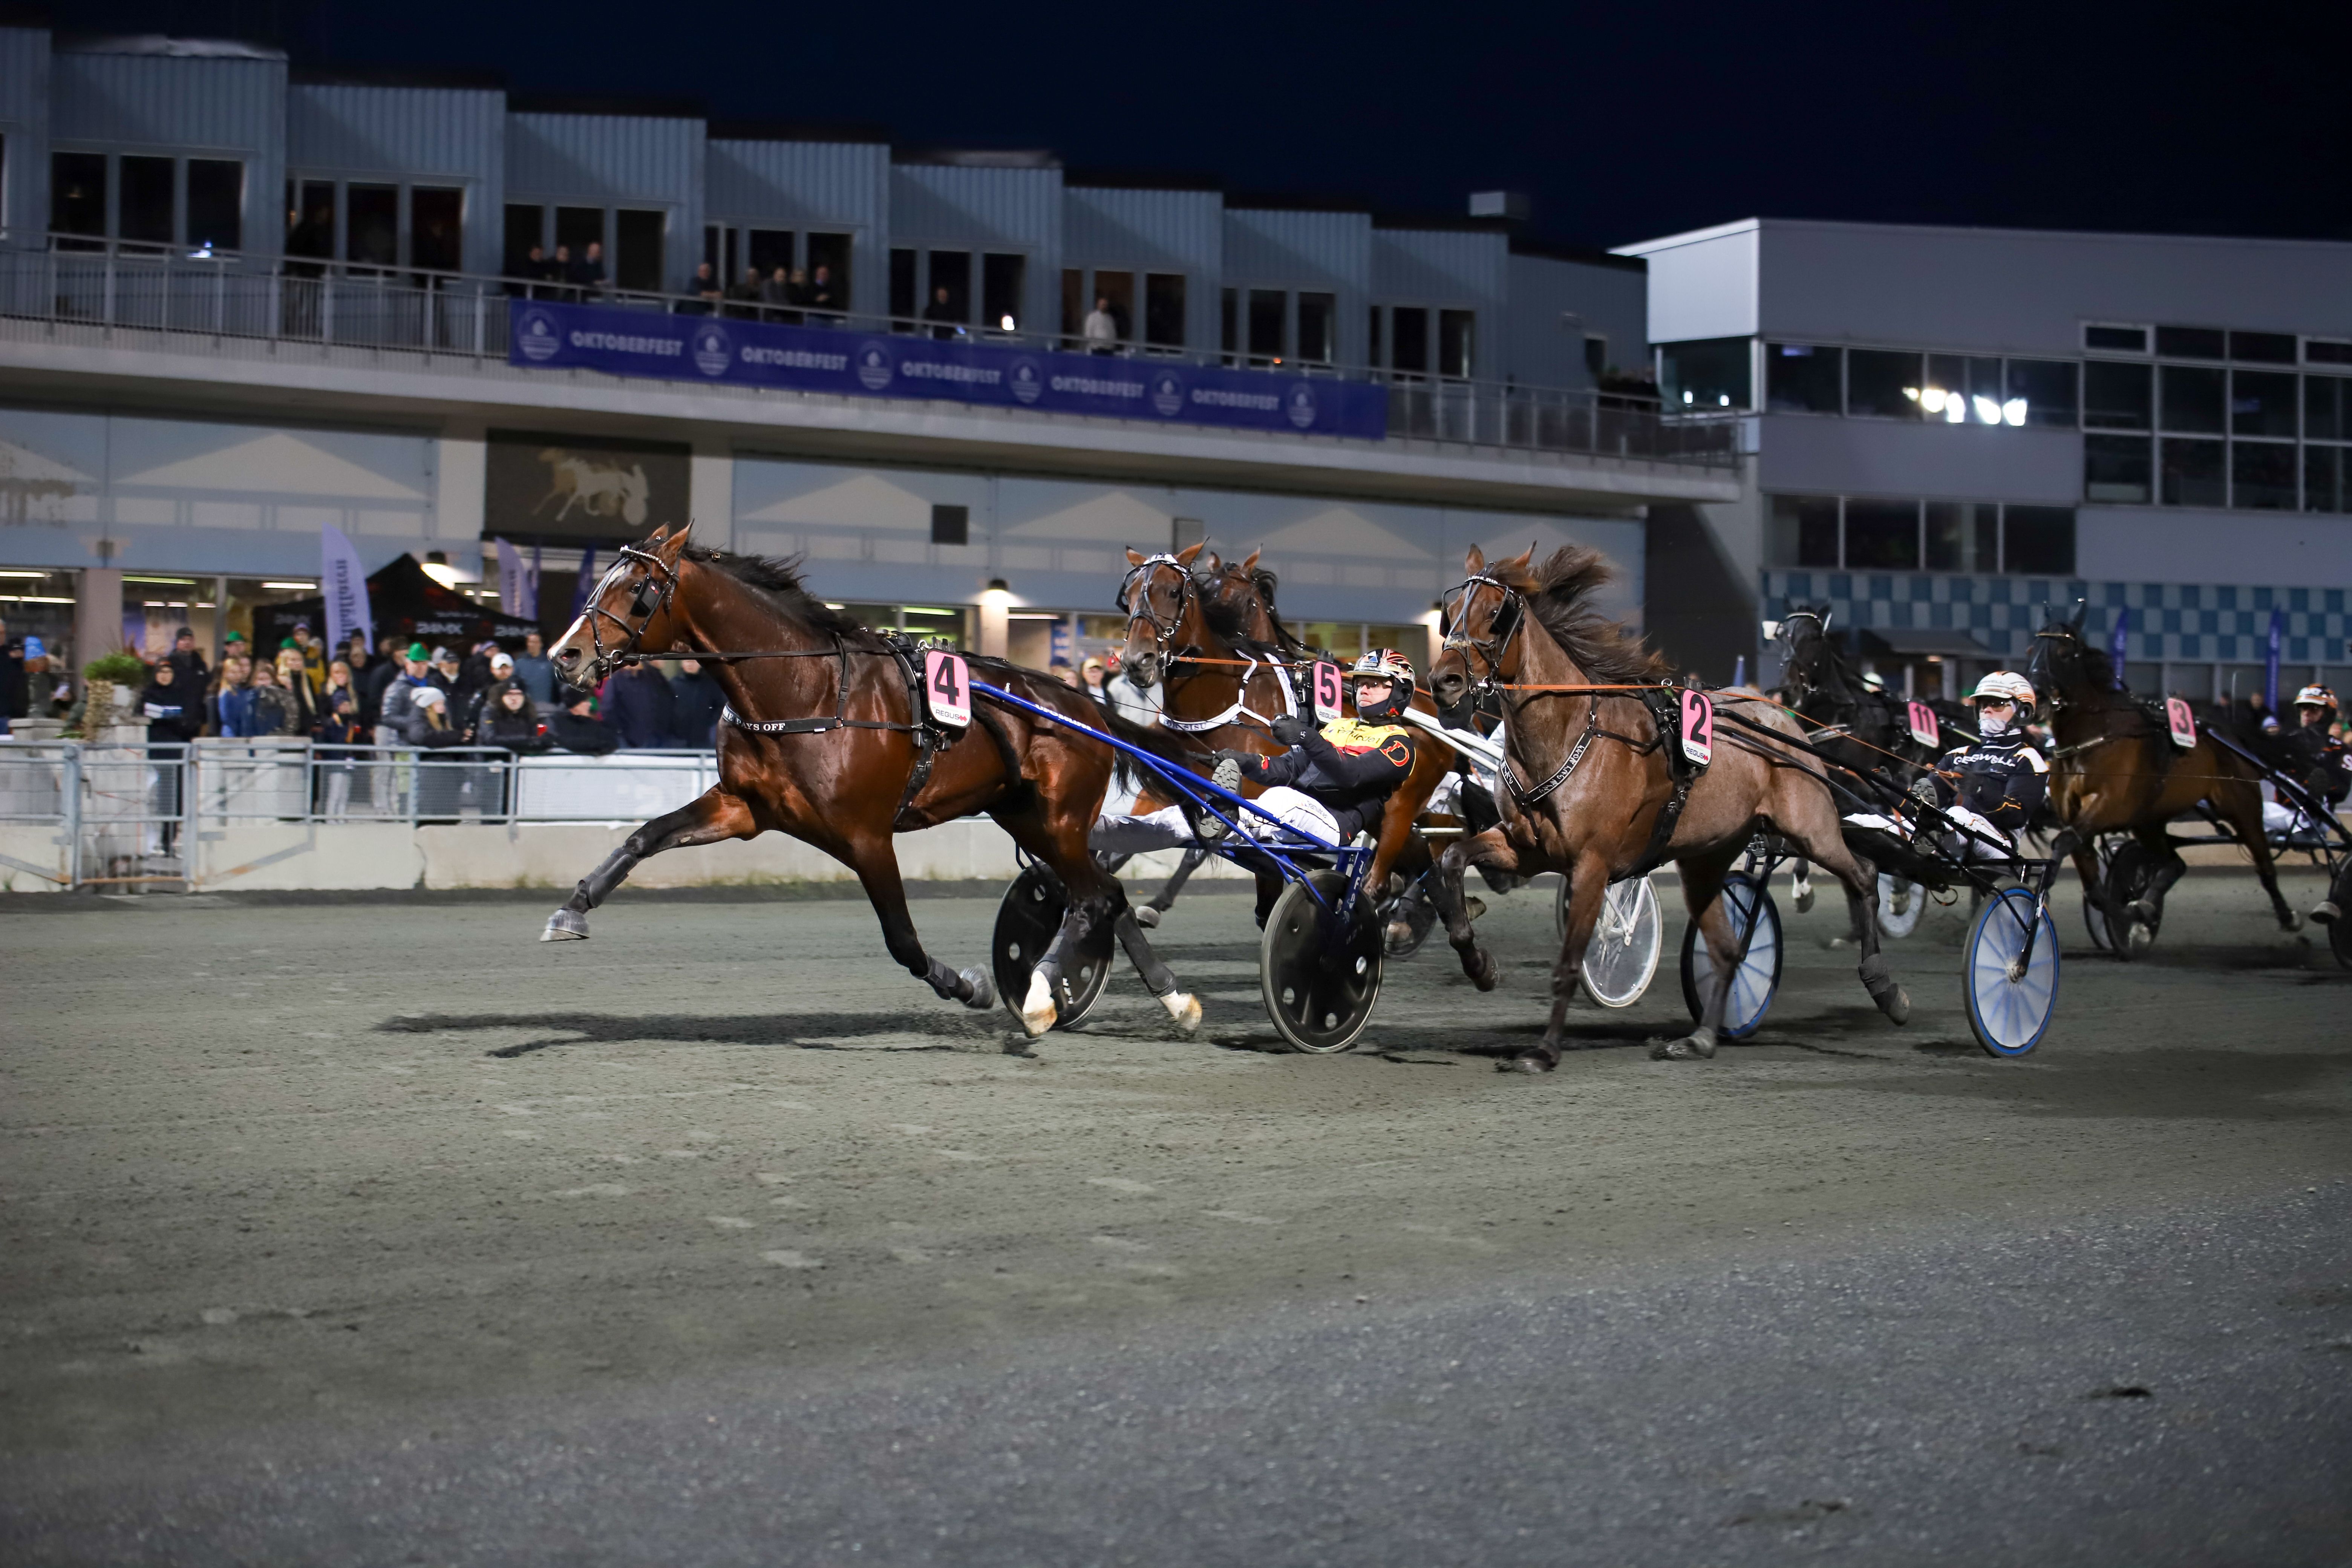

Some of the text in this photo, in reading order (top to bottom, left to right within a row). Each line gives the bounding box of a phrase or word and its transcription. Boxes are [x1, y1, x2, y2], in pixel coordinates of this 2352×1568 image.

[570, 330, 683, 356] OKTOBERFEST
[741, 347, 848, 371] OKTOBERFEST
[902, 361, 1001, 385] OKTOBERFEST
[1050, 375, 1144, 398] OKTOBERFEST
[1191, 388, 1279, 410] OKTOBERFEST
[934, 656, 959, 706] 4
[1320, 664, 1336, 707] 5
[737, 718, 760, 731] PAYS
[936, 709, 960, 720] REGUS
[1690, 694, 1707, 745] 2
[1915, 705, 1932, 735] 11
[2173, 701, 2189, 734] 3
[1686, 747, 1704, 759] REGUS
